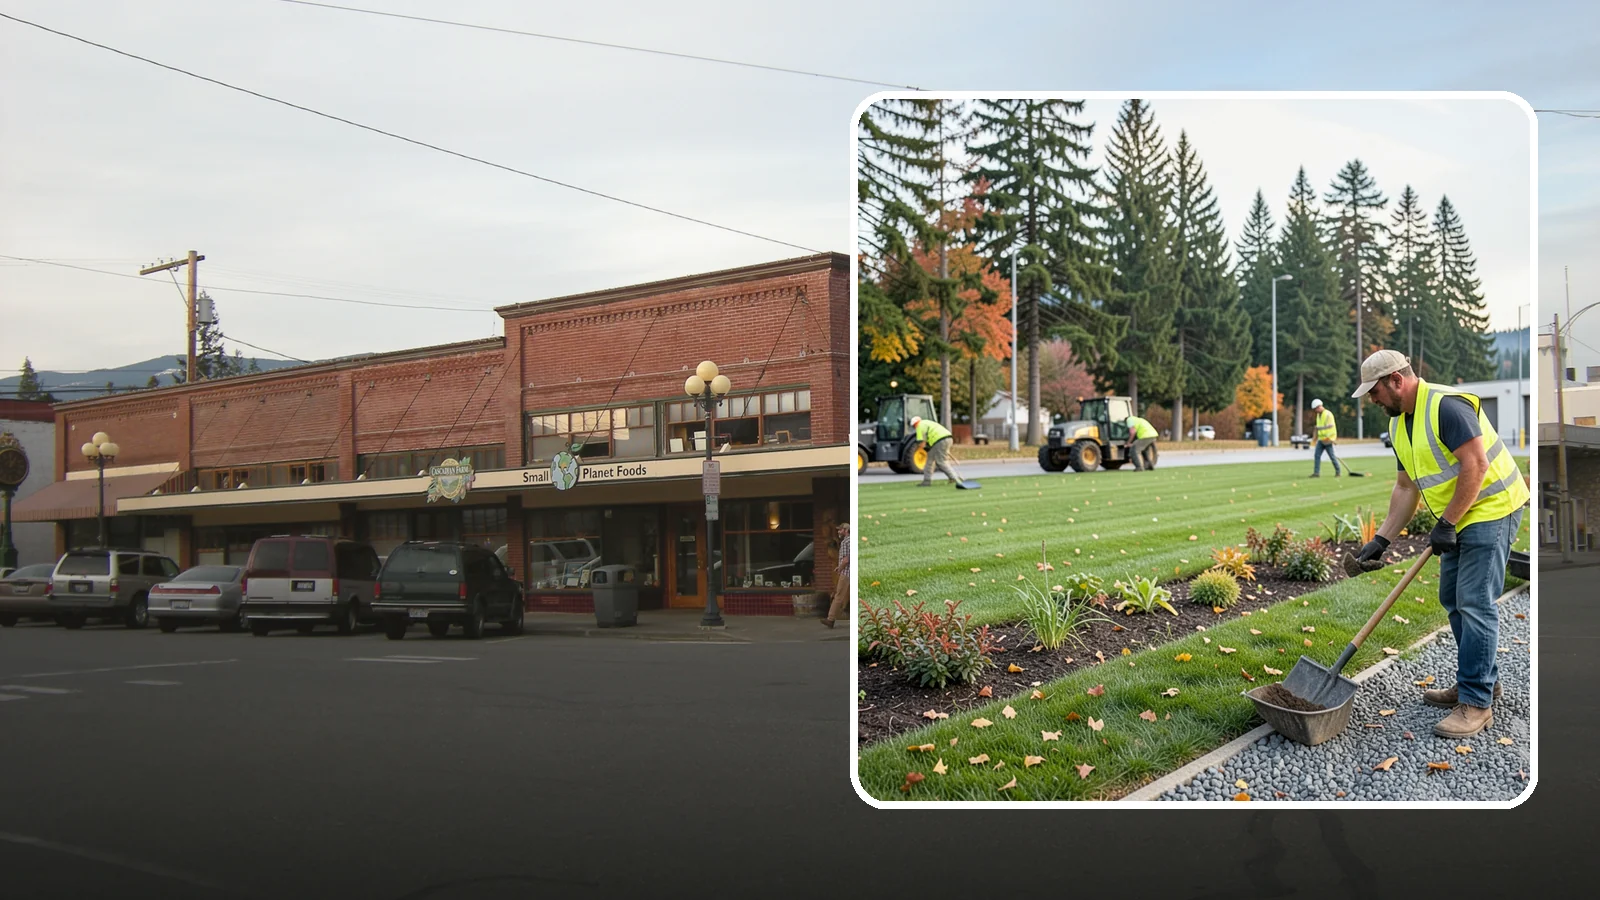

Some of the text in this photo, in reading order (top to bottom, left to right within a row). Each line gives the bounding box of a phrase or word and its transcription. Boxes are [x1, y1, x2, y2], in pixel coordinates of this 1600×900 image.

[523, 464, 647, 483] Small Planet Foods
